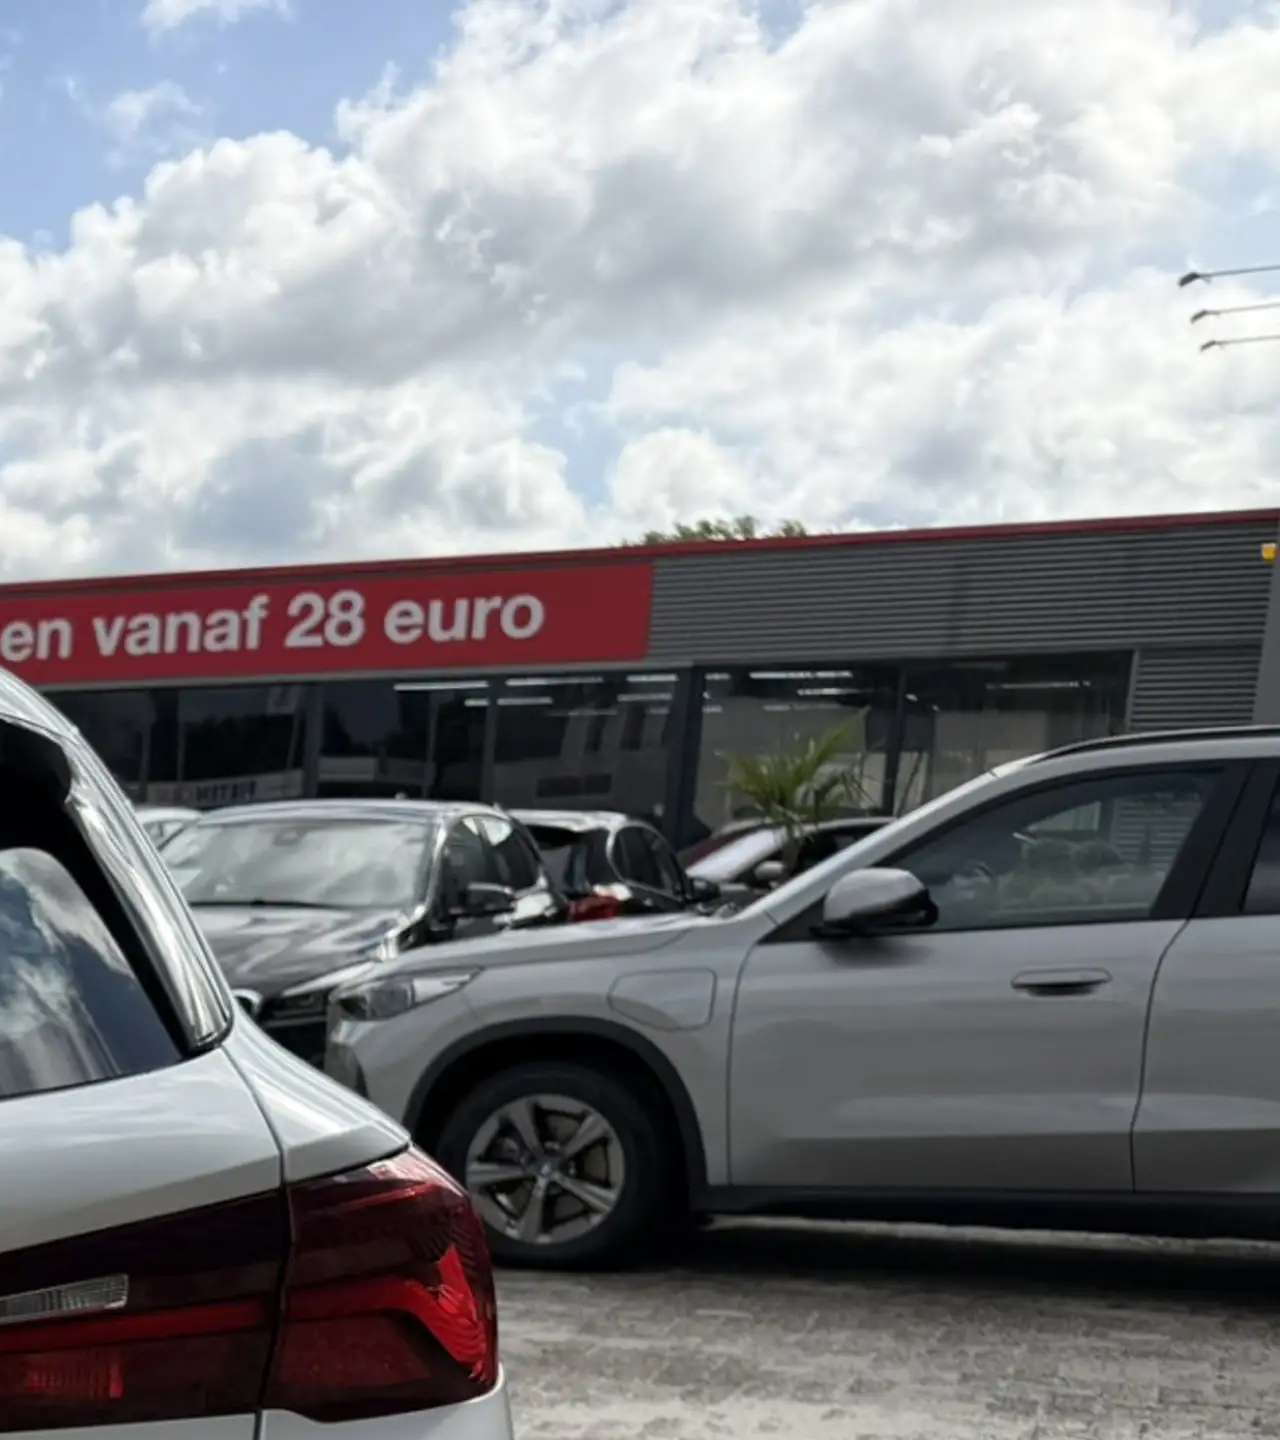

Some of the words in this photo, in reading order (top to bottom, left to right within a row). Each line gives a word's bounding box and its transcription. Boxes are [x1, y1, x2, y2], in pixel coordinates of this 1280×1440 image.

[92, 593, 269, 657] vanaf
[282, 589, 366, 649] 28
[383, 592, 544, 645] euro
